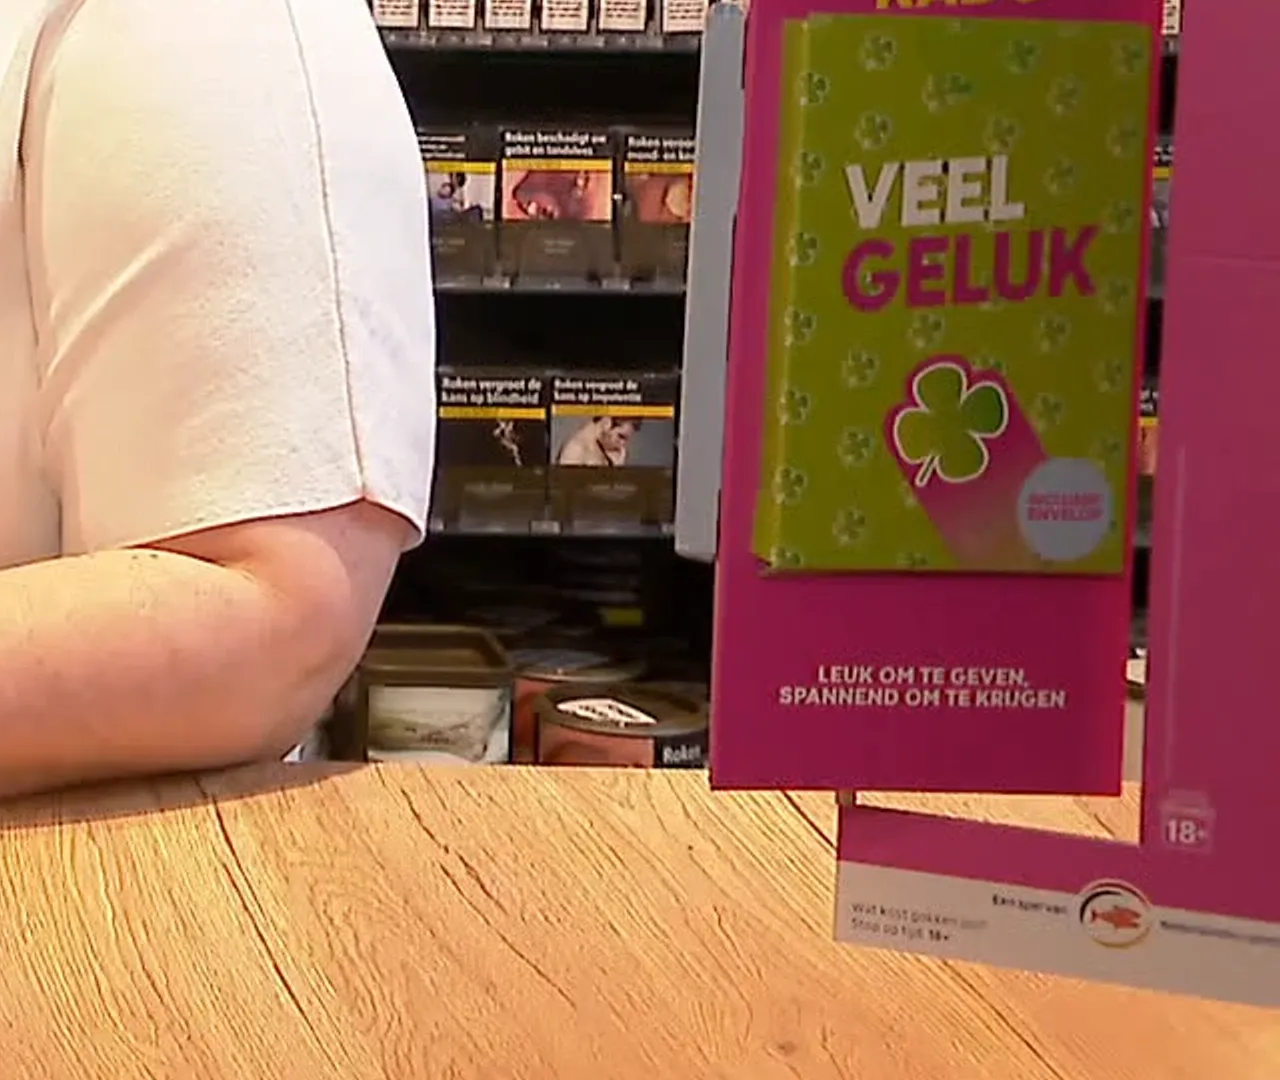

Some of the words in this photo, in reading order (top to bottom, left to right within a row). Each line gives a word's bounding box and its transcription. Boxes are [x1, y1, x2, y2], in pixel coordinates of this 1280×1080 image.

[845, 155, 1025, 229] VEEL
[841, 225, 1099, 312] GELUK
[818, 665, 873, 685] LEUK
[879, 667, 914, 685] OM
[920, 667, 945, 686] TE
[950, 668, 1030, 689] GEVEN,
[779, 686, 899, 707] SPANNEND
[905, 688, 940, 707] OM
[945, 689, 971, 707] TE
[975, 689, 1066, 709] KRIJGEN
[1166, 820, 1208, 843] 18+
